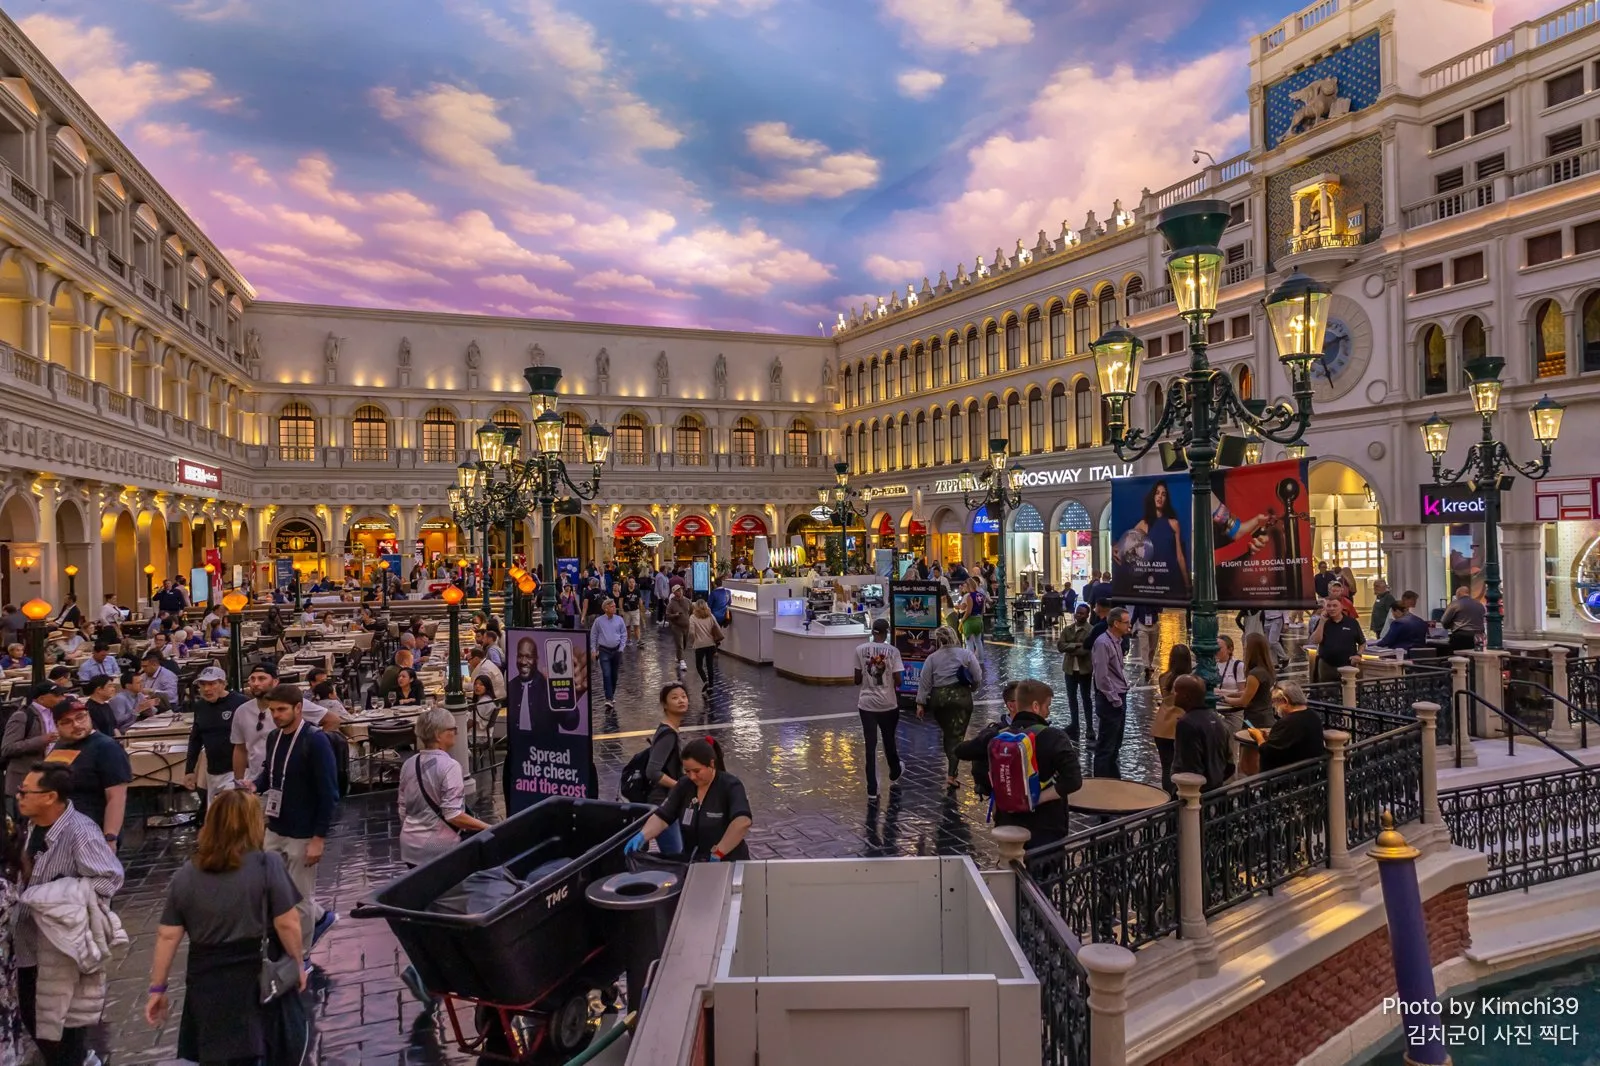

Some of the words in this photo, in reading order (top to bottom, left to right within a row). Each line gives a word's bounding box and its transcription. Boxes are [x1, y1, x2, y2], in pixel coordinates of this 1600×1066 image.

[1441, 497, 1486, 512] kreat
[1261, 558, 1285, 566] SOCIAL
[1286, 557, 1309, 565] DARTS
[529, 746, 571, 765] Spread
[522, 760, 542, 777] the
[543, 763, 579, 784] cheer,
[515, 777, 537, 793] and
[539, 779, 558, 795] the
[560, 783, 587, 798] cost
[545, 885, 569, 909] TMG
